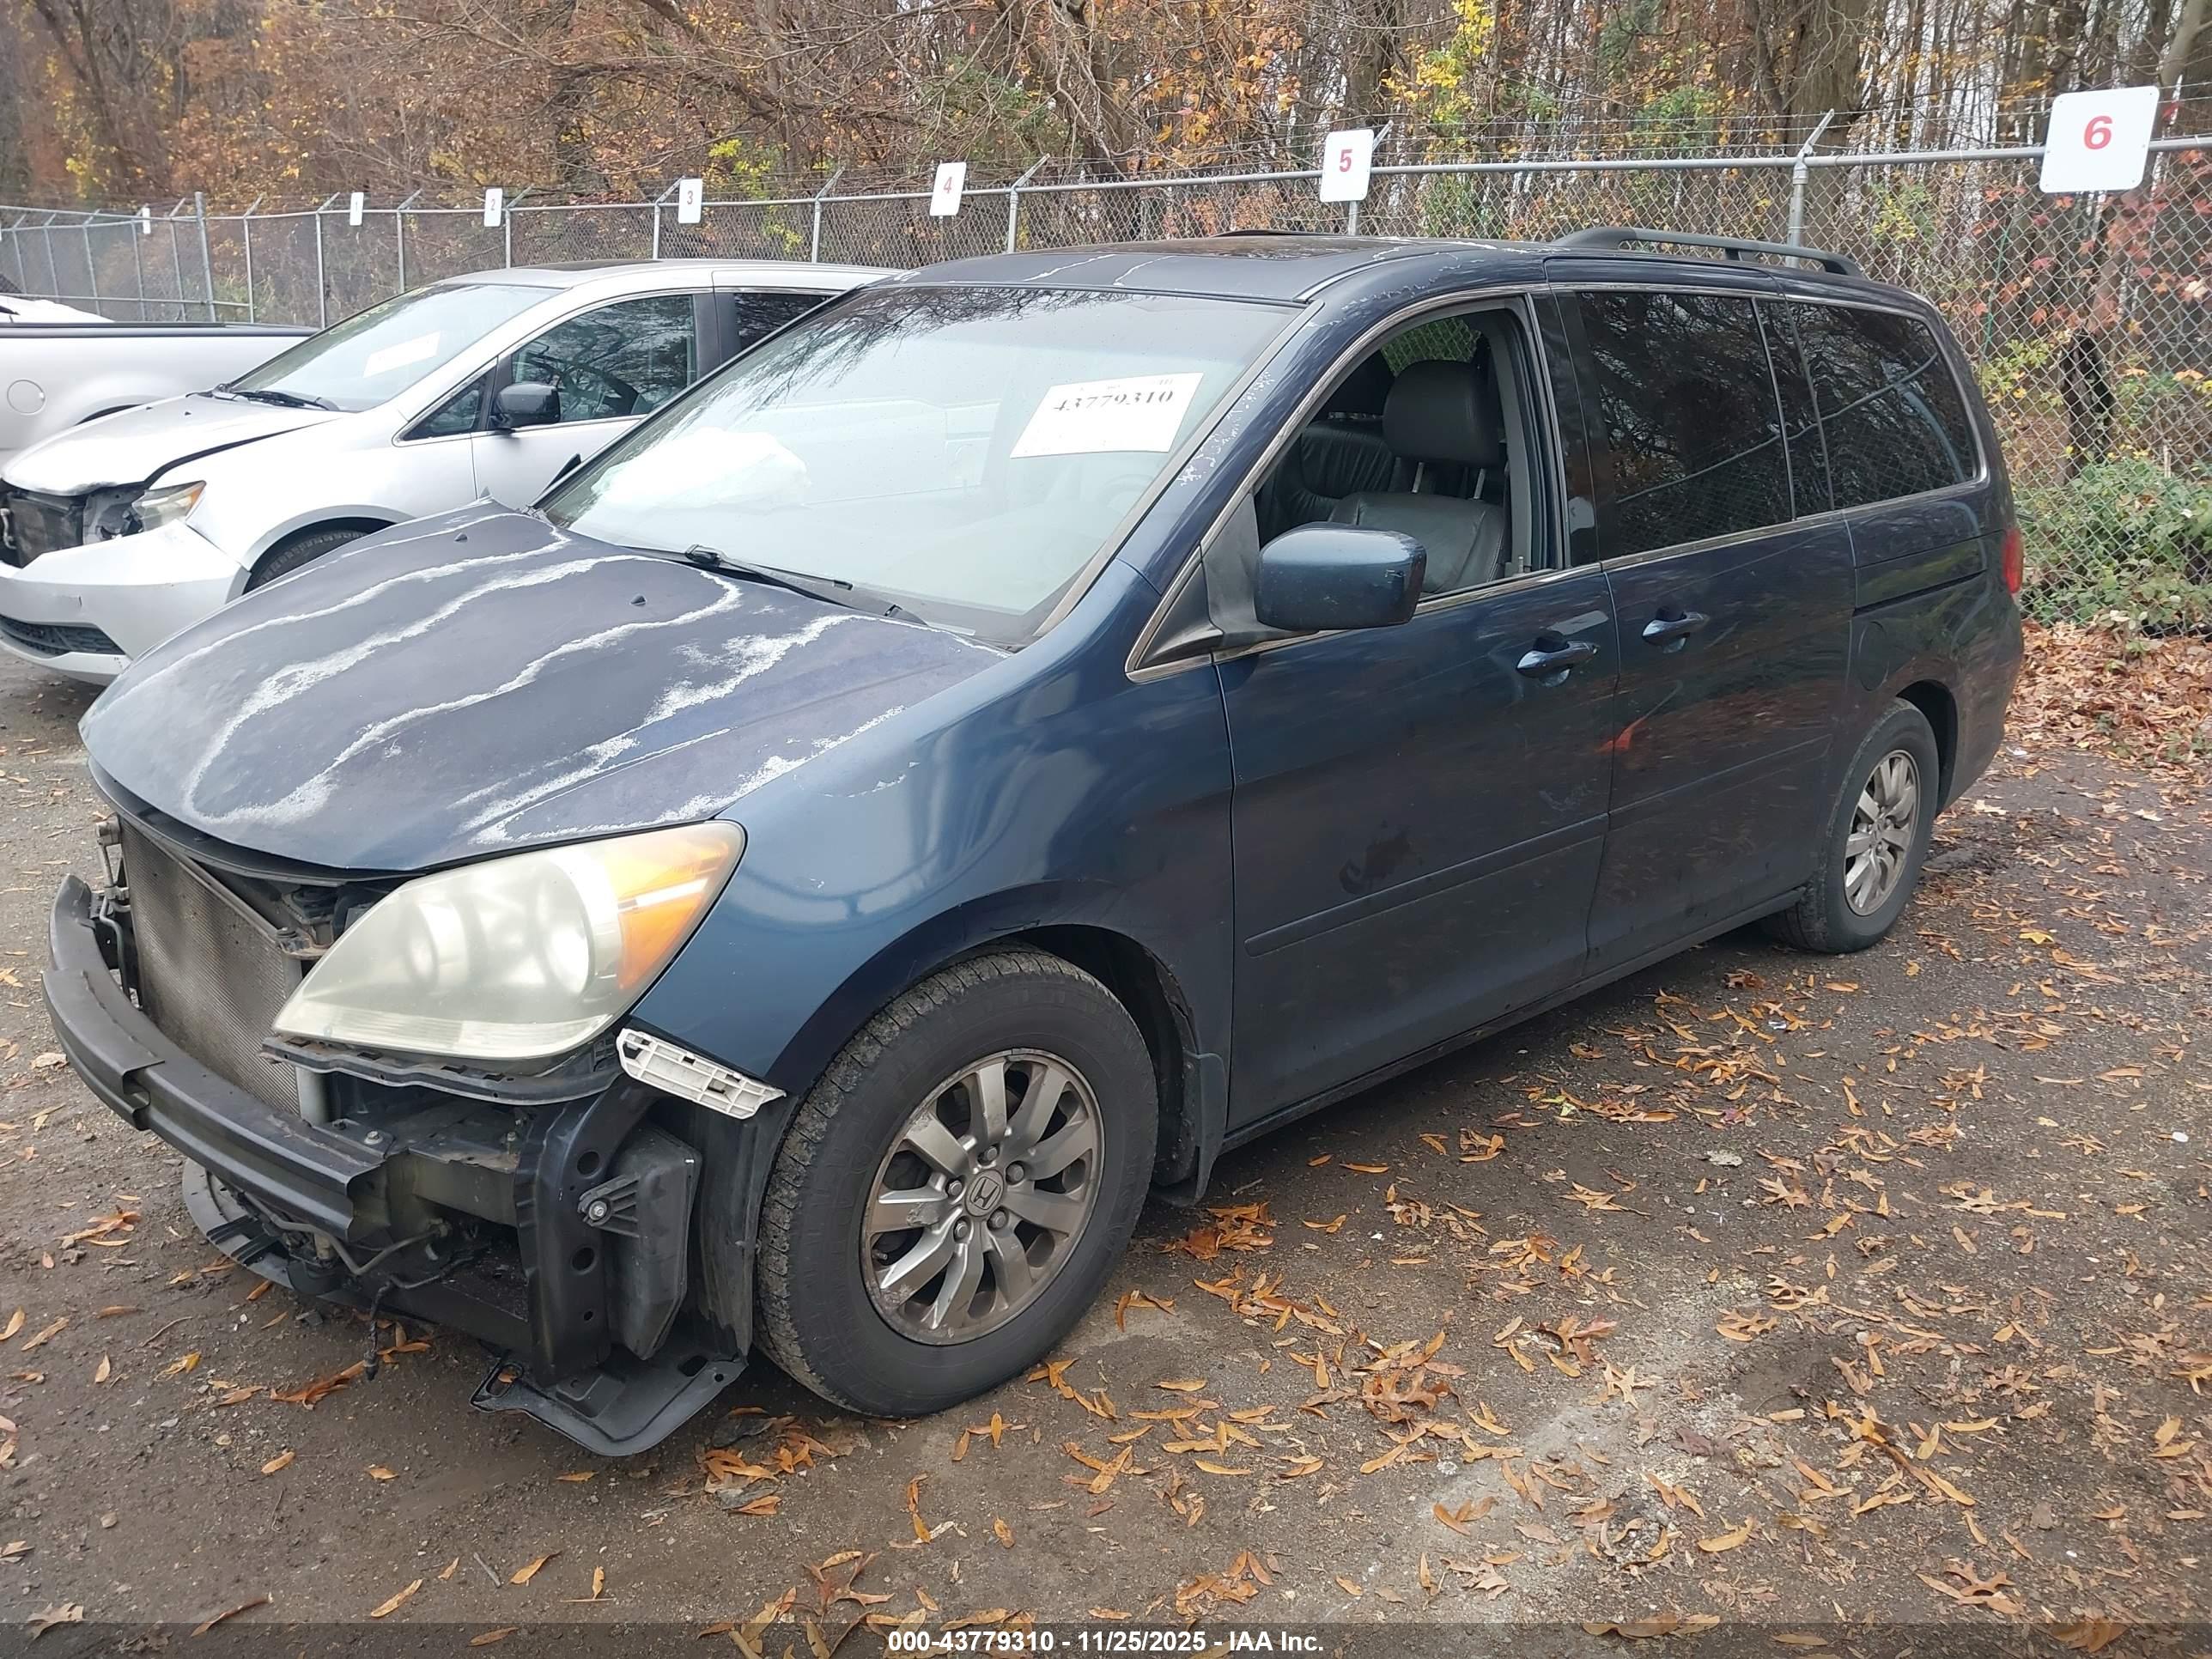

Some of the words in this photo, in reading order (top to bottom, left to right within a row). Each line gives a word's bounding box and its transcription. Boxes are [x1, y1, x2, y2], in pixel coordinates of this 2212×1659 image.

[2083, 114, 2113, 151] 6
[1339, 148, 1353, 173] 5
[943, 175, 953, 195] 4
[490, 198, 496, 211] 2
[686, 190, 694, 205] 3
[1053, 390, 1175, 412] 43779310
